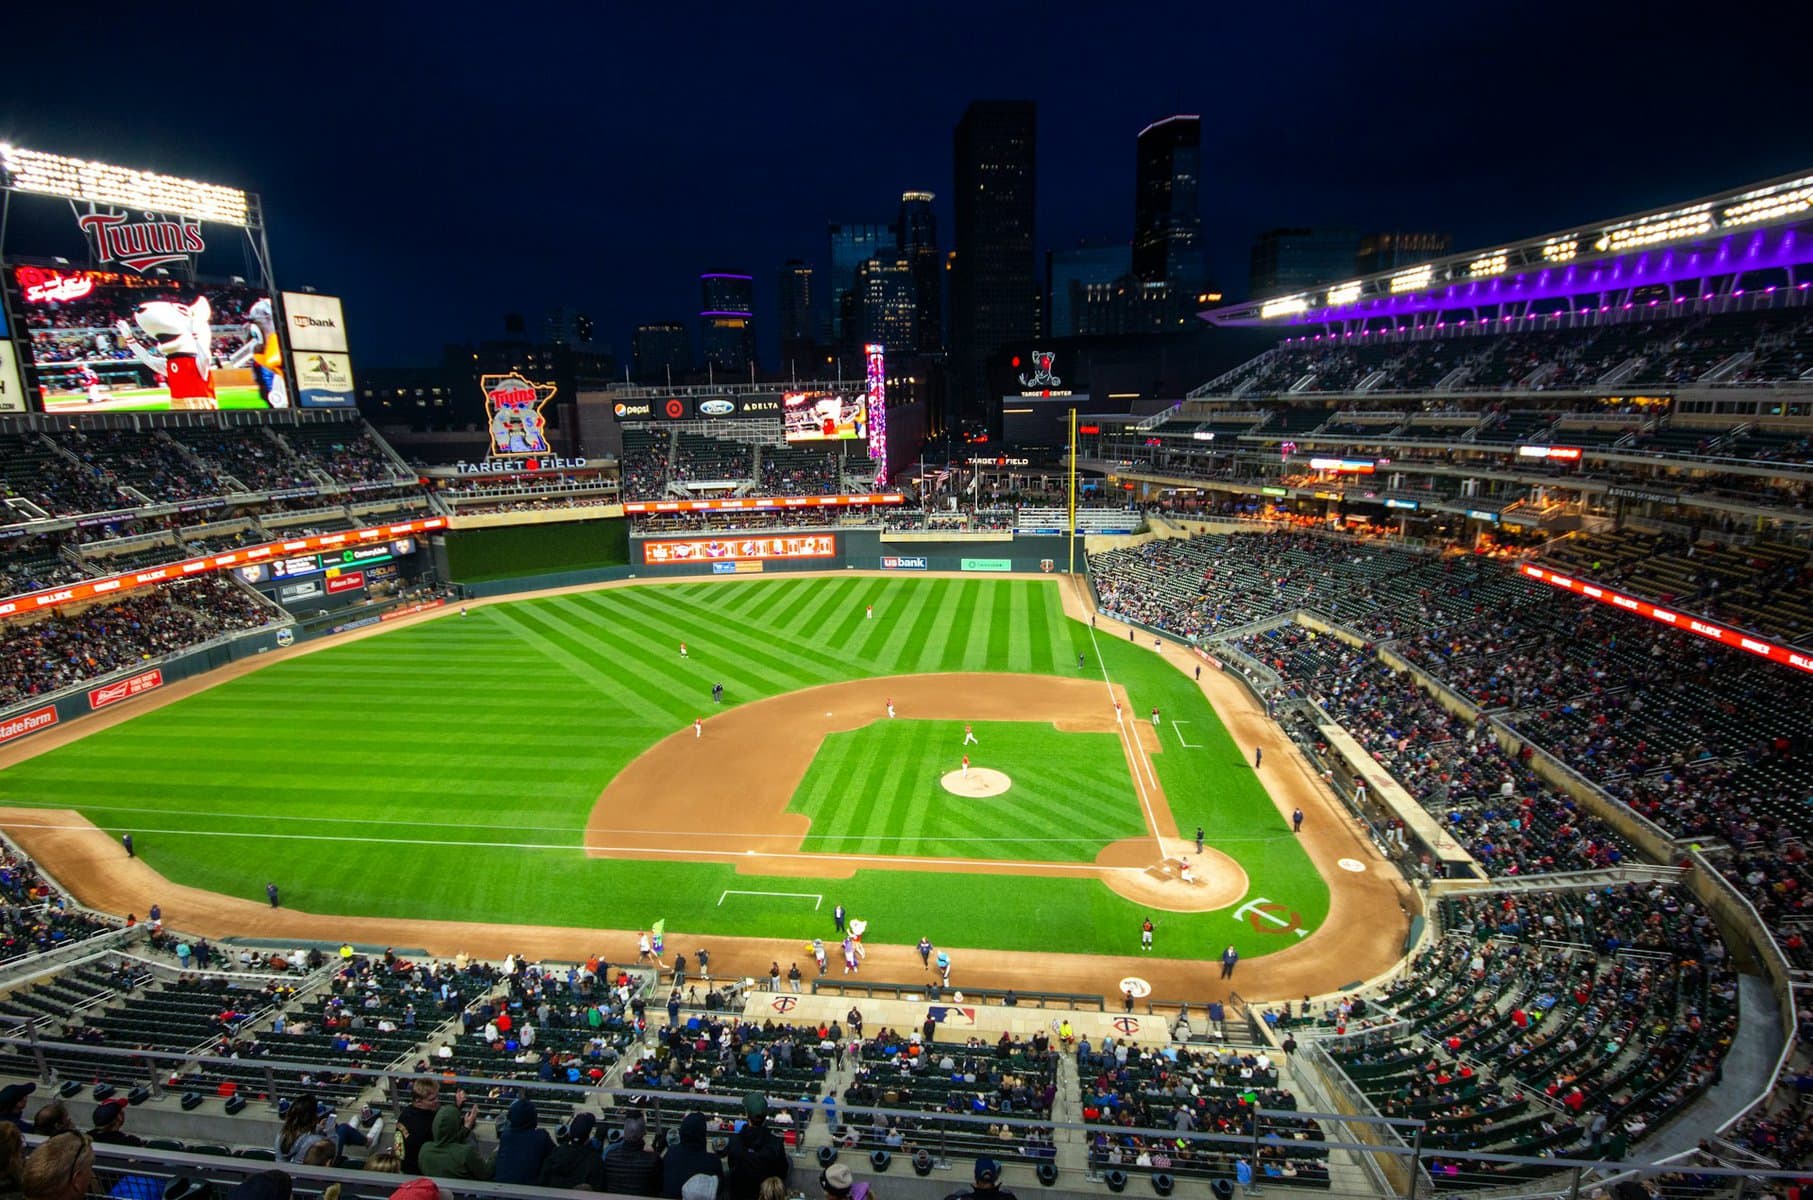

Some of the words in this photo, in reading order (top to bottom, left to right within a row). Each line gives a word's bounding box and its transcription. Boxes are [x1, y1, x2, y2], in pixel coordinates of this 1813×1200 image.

[79, 210, 205, 264] Twins
[489, 386, 537, 410] Twins
[626, 404, 650, 415] pepsi
[751, 402, 778, 411] DELTA
[457, 460, 525, 474] TARGET
[540, 458, 587, 471] FIELD
[967, 457, 996, 465] TARGET
